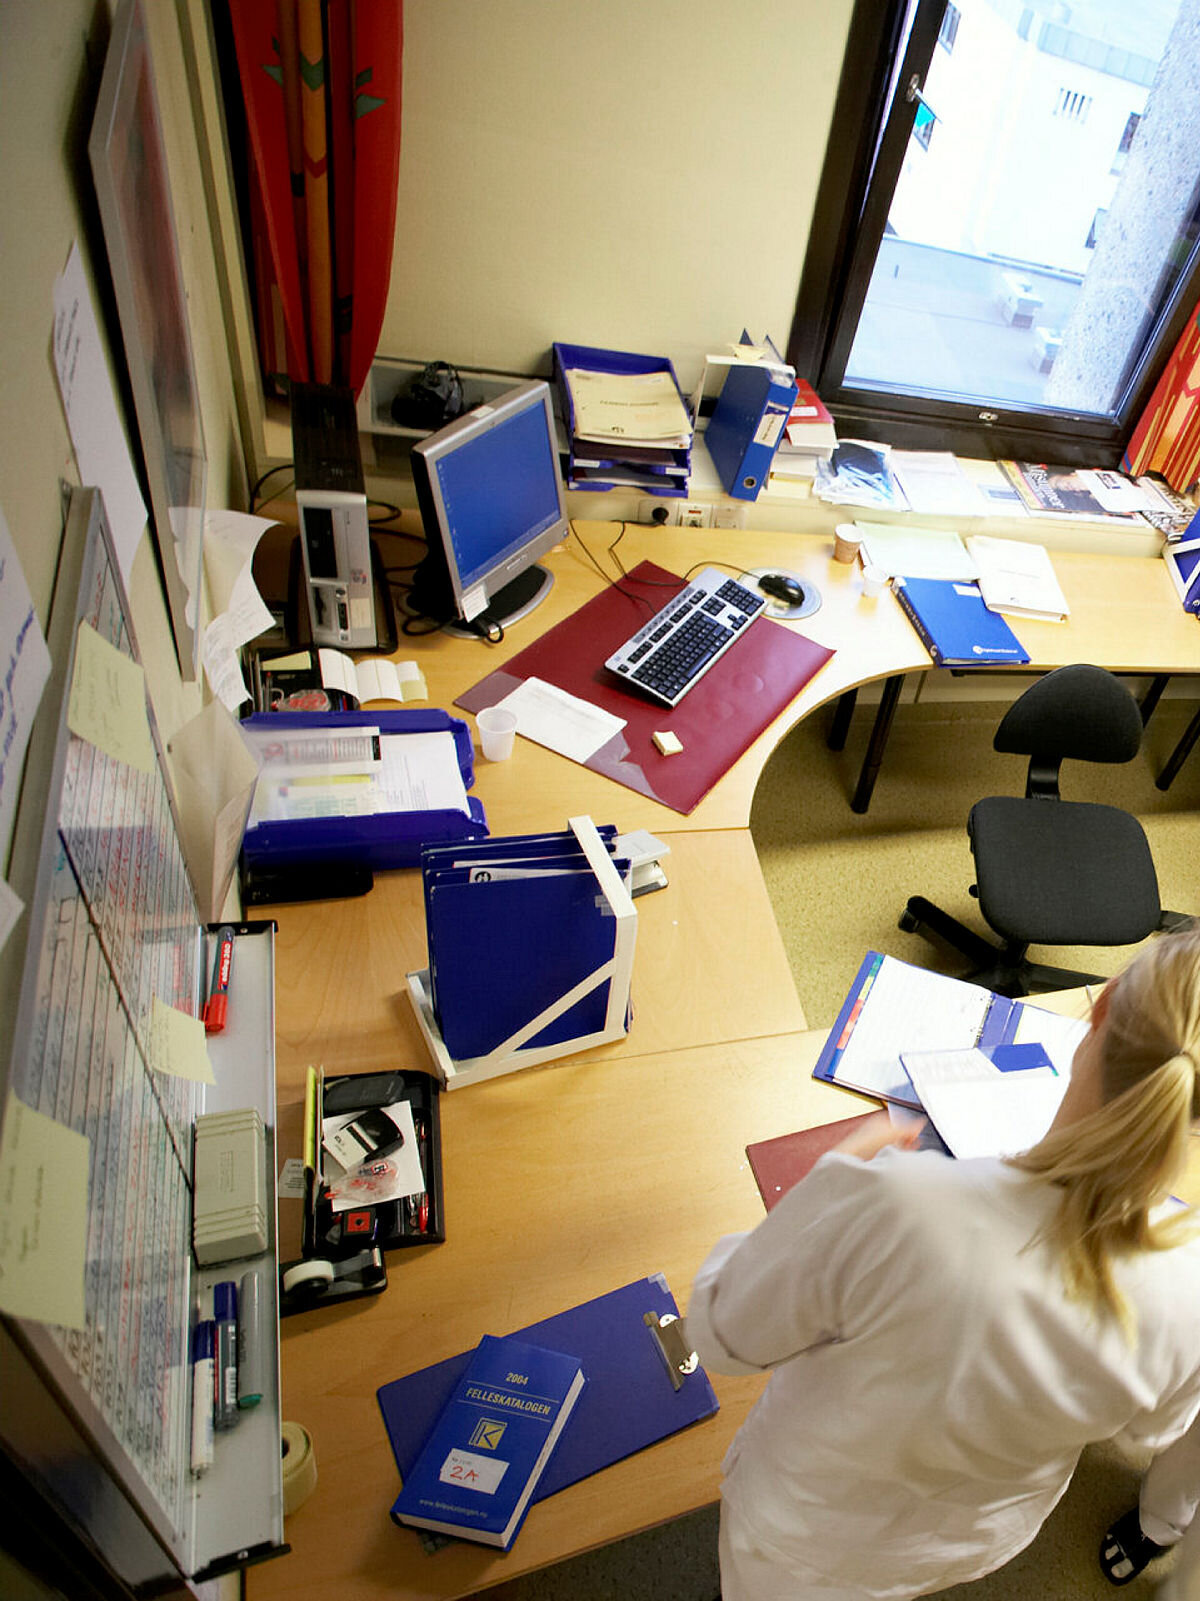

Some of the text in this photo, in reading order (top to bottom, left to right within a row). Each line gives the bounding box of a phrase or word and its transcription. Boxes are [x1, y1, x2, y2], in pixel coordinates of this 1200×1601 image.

[506, 1372, 529, 1385] 2004
[466, 1388, 551, 1415] FELLESKATALOGEN
[449, 1465, 479, 1482] 2A
